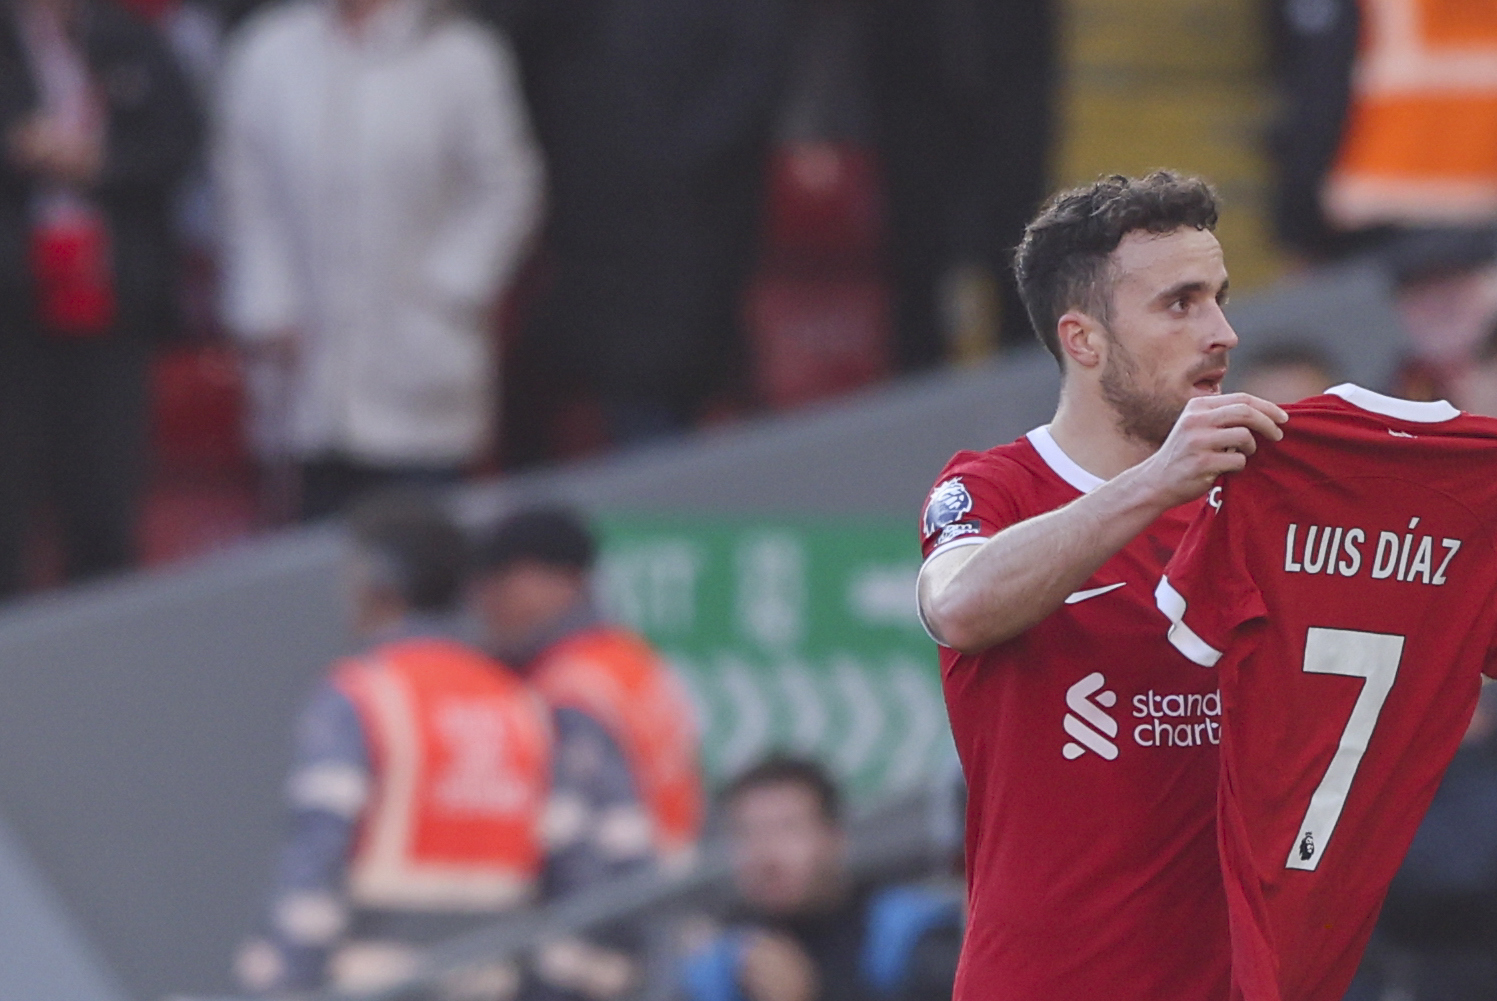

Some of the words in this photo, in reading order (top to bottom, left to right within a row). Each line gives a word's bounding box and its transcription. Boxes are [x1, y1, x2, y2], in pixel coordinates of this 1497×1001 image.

[1284, 523, 1366, 577] LUIS
[1371, 516, 1462, 586] DÍAZ
[1132, 688, 1222, 718] stand
[1133, 717, 1222, 747] chart
[1284, 627, 1405, 871] 7
